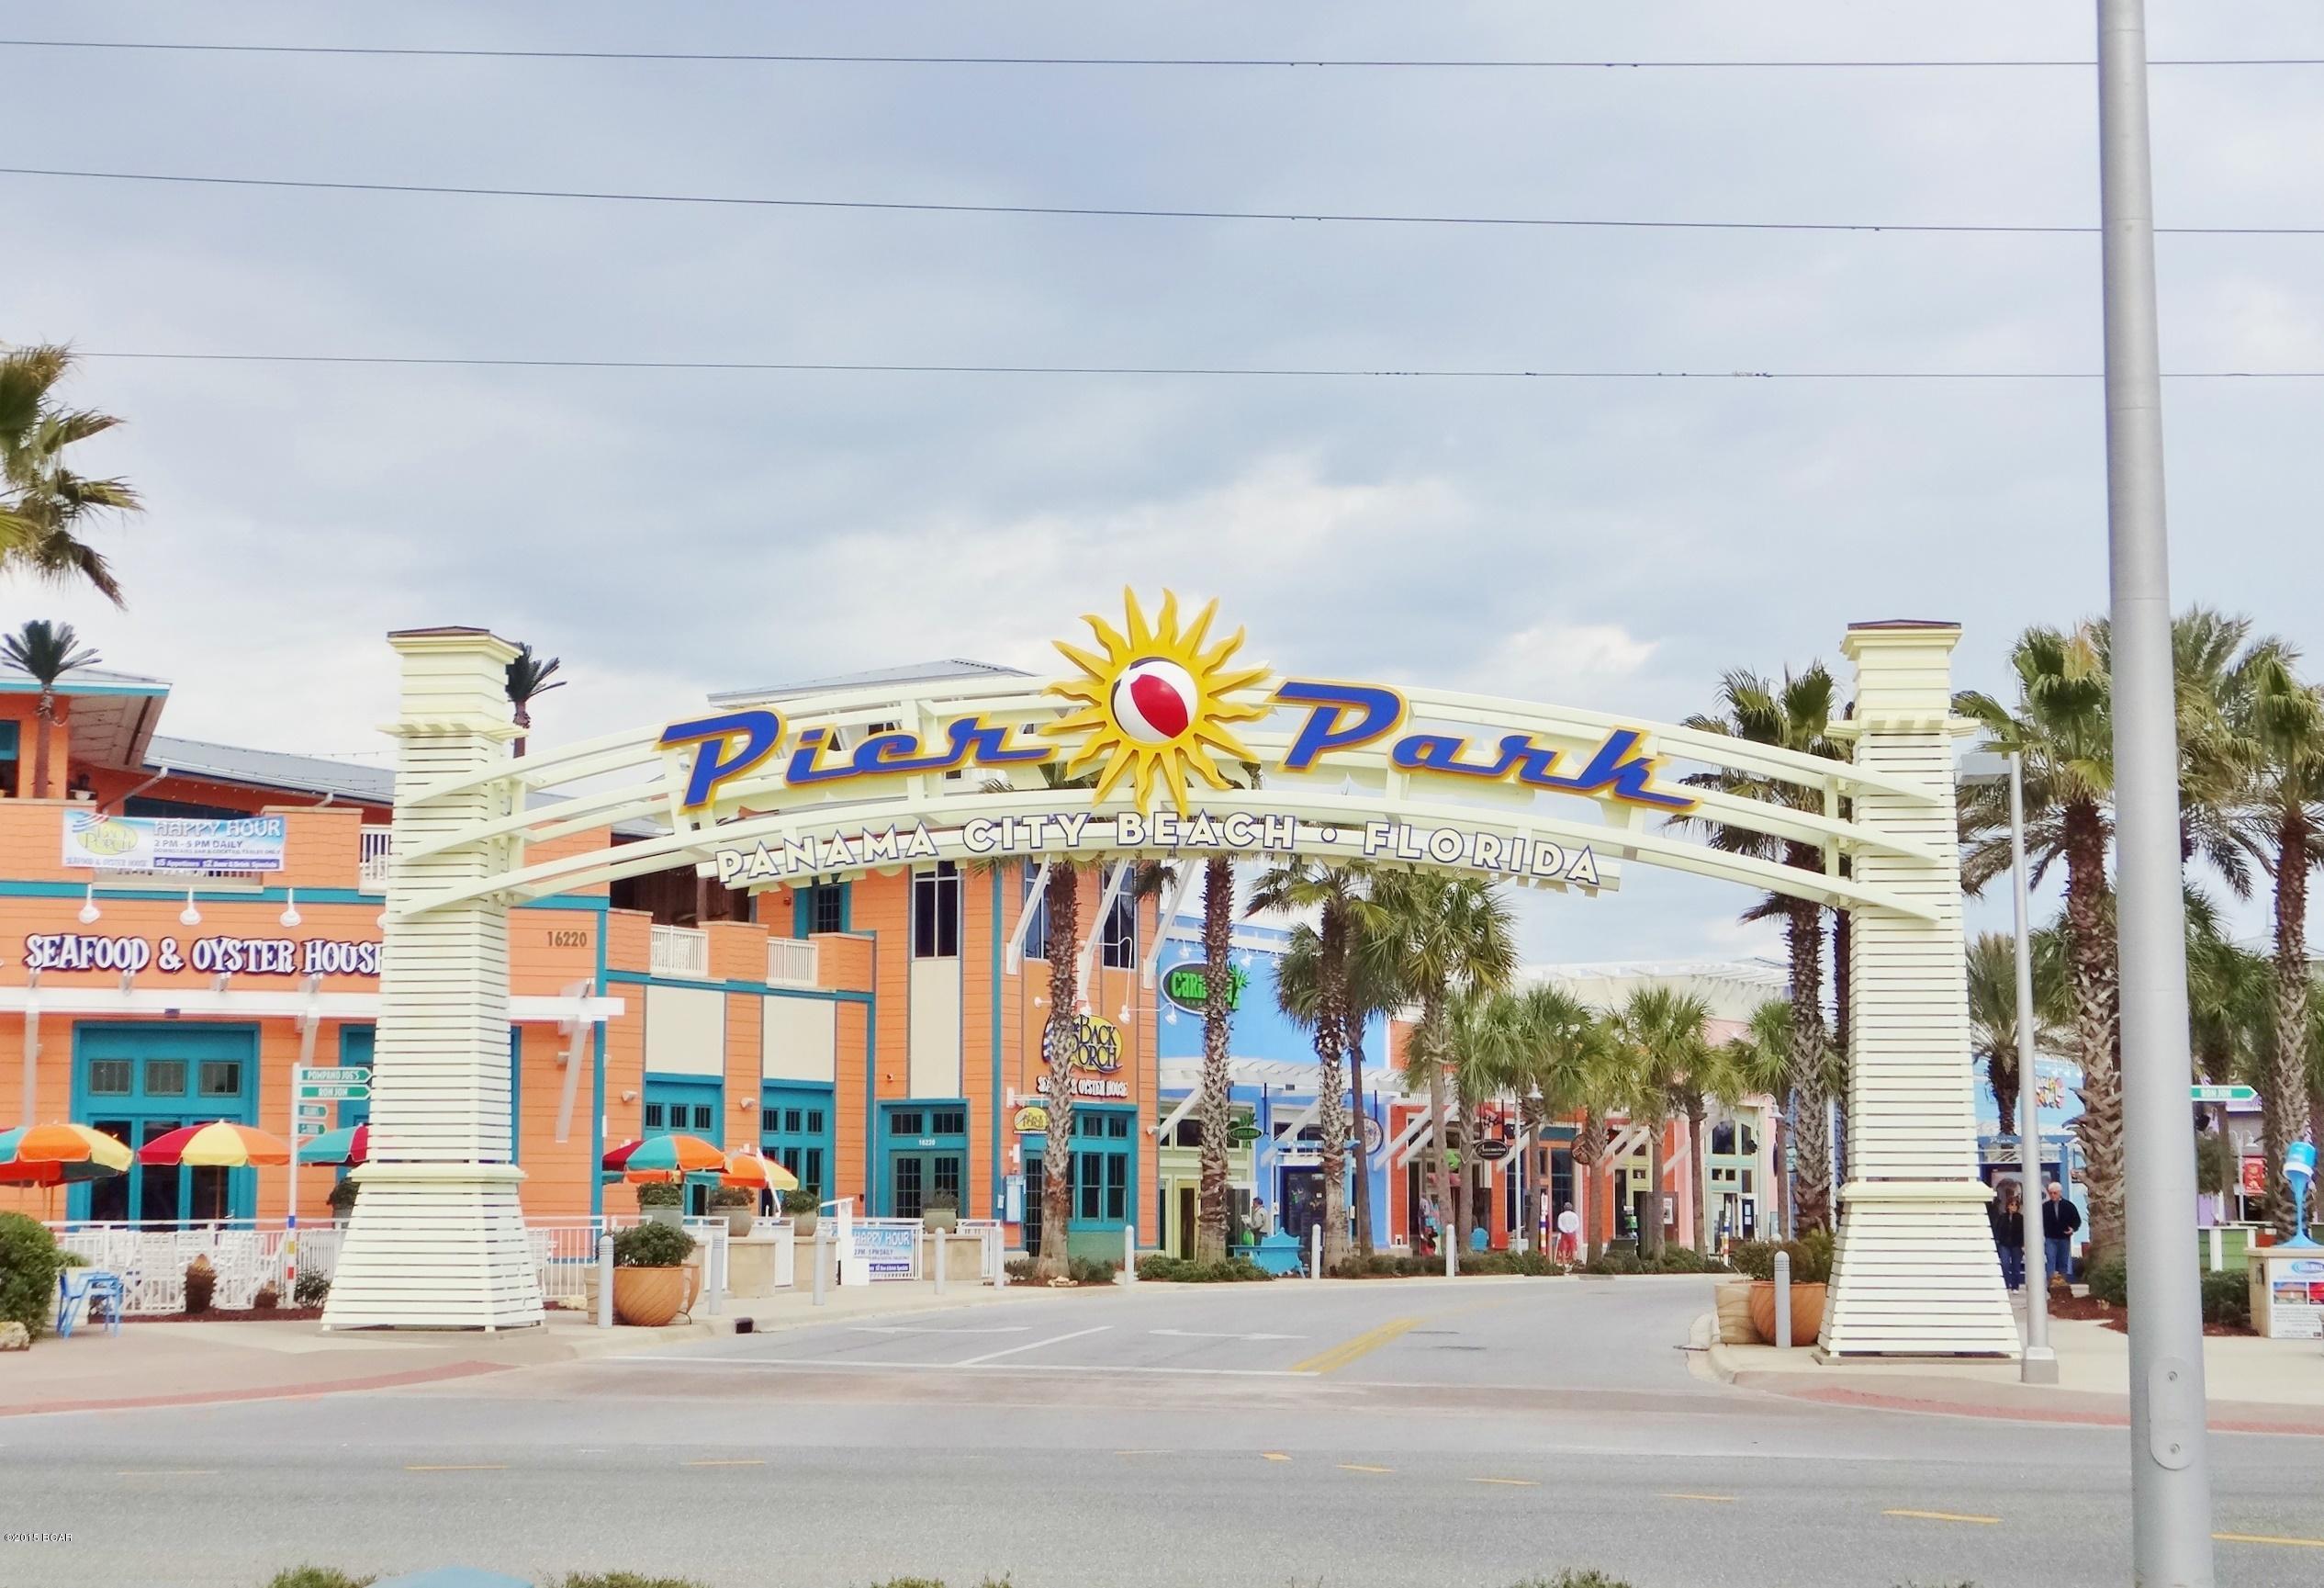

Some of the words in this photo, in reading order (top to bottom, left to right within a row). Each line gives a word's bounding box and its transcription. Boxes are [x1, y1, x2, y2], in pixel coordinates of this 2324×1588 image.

[656, 706, 1059, 812] Pier
[1274, 679, 1700, 810] Park
[153, 819, 219, 837] HAPPY
[226, 818, 282, 838] HOUR
[212, 840, 242, 849] DAILY
[715, 819, 938, 884] PANAMA
[962, 812, 1091, 852] CITY
[1117, 808, 1296, 850] BEACH
[1364, 820, 1600, 885] FLORIDA
[547, 931, 587, 947] 16220
[25, 933, 151, 973] SEAFOOD
[159, 937, 185, 972] &
[191, 935, 296, 974] OYSTER
[1079, 1014, 1117, 1046] BACK
[307, 1069, 341, 1081] POMPANO
[342, 1069, 360, 1081] JOE'S
[318, 1087, 332, 1098] RON
[333, 1087, 348, 1098] JON
[1077, 1077, 1105, 1096] OYSTER
[1106, 1080, 1128, 1098] HOUSE
[853, 1232, 883, 1246] HAPPY
[885, 1231, 911, 1246] HOUR
